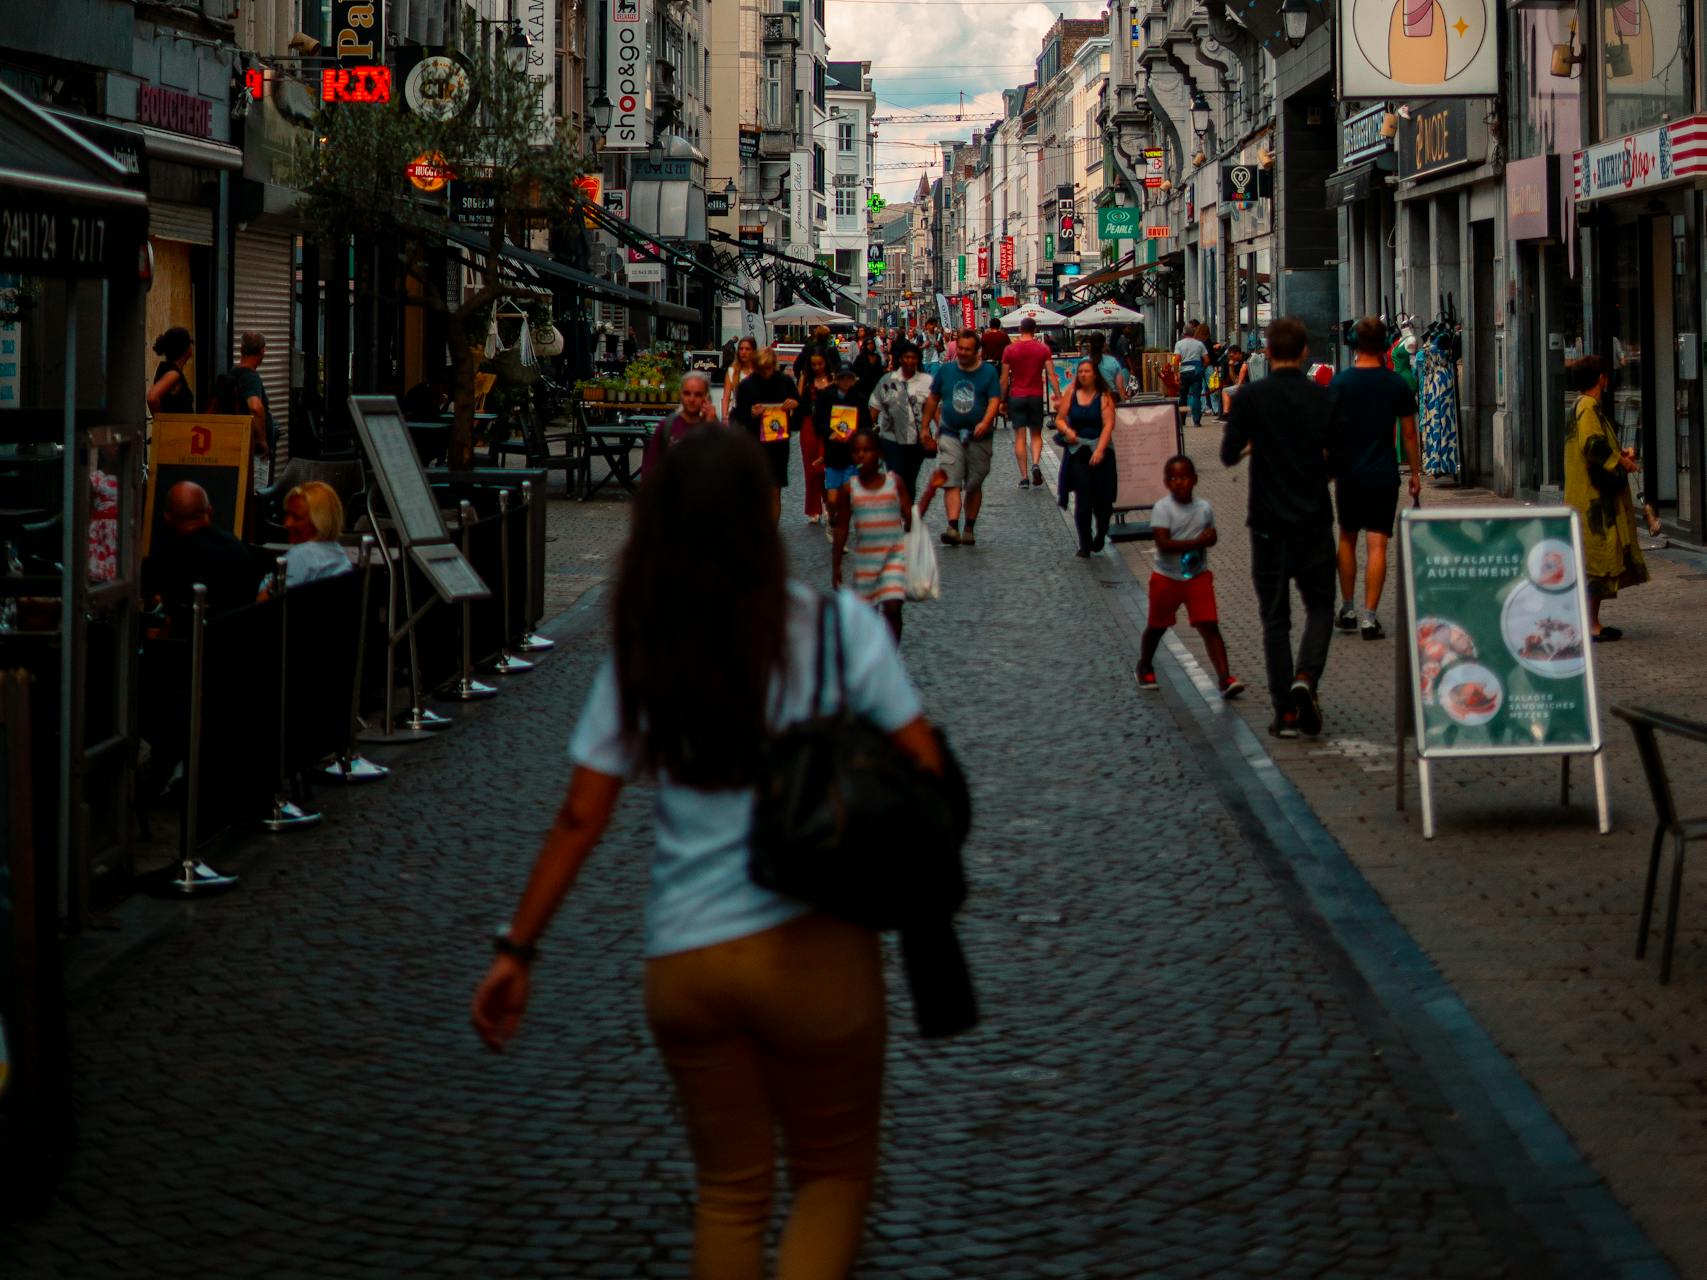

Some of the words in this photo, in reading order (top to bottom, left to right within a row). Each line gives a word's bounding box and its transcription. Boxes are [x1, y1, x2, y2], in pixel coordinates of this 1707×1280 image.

[140, 83, 213, 137] BOUCHERIE
[615, 28, 640, 141] shop&go
[1624, 137, 1649, 188] Shop
[1105, 223, 1134, 234] PEARLE
[1509, 701, 1576, 710] SANDWICHES
